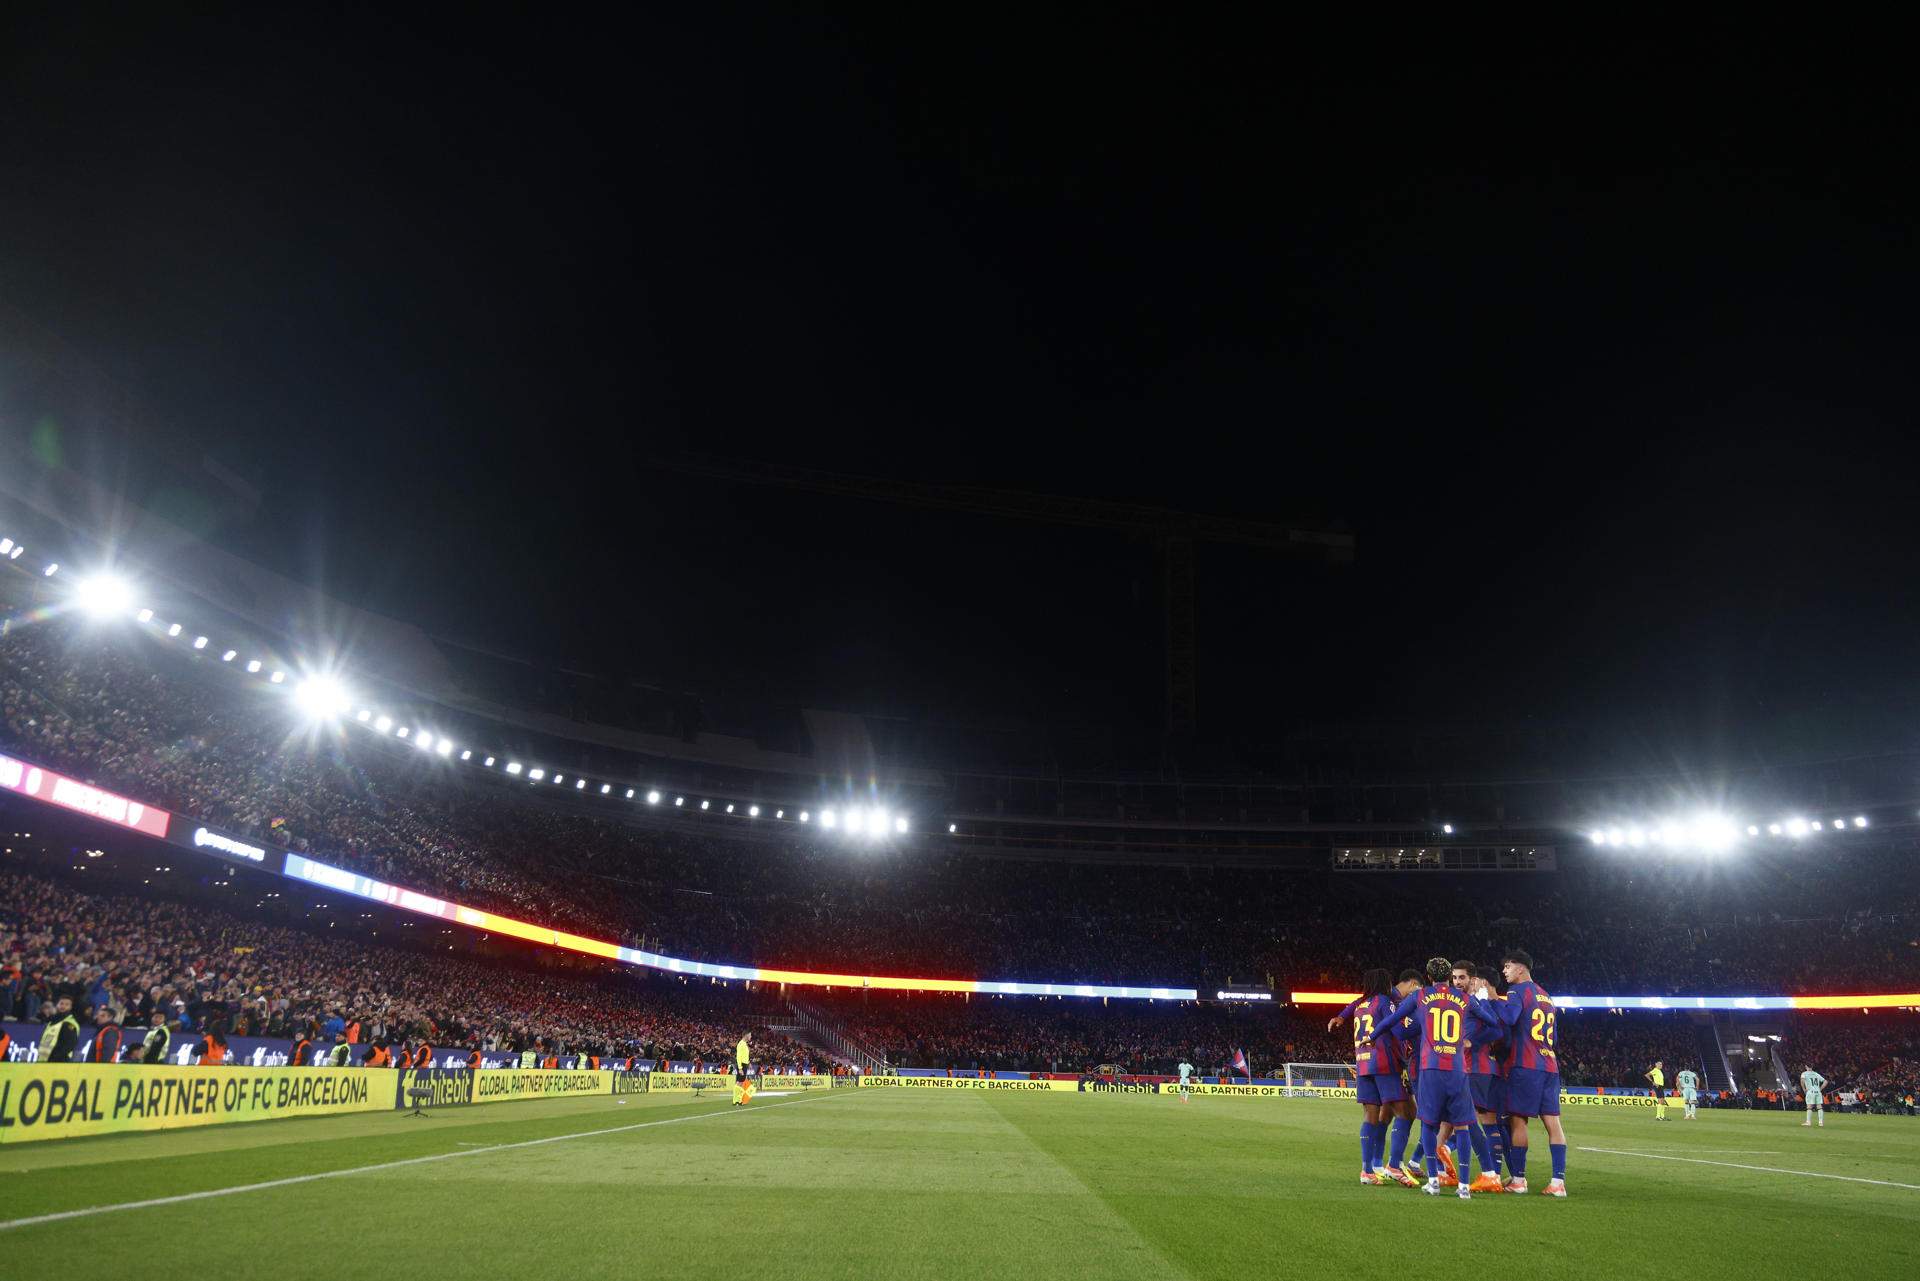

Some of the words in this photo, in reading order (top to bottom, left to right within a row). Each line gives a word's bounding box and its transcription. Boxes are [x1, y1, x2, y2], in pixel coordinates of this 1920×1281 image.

[1421, 993, 1445, 1005] LAMINE
[1446, 993, 1467, 1010] YAMAL
[1353, 1014, 1375, 1047] 23
[1429, 1007, 1461, 1043] 10
[1531, 1008, 1555, 1046] 22
[479, 1076, 509, 1096] GLOBAL
[511, 1075, 543, 1094] PARTNER
[544, 1075, 554, 1092] OF
[554, 1075, 563, 1092] FC
[563, 1075, 600, 1092] BARCELONA
[864, 1078, 903, 1087] GLOBAL
[906, 1078, 953, 1088] PARTNER
[956, 1080, 969, 1088] OF
[972, 1080, 985, 1089] FC
[989, 1081, 1051, 1090] BARCELONA
[1096, 1082, 1154, 1094] whitebit
[1684, 1075, 1690, 1084] 6
[113, 1078, 219, 1120] PARTNER
[224, 1077, 249, 1112] OF
[251, 1077, 274, 1110] FC
[276, 1076, 368, 1108] BARCELONA
[1167, 1085, 1208, 1094] GLBAL
[1211, 1086, 1258, 1095] PARTNER
[1262, 1087, 1275, 1096] OF
[1569, 1096, 1583, 1104] OF
[1587, 1097, 1600, 1105] FC
